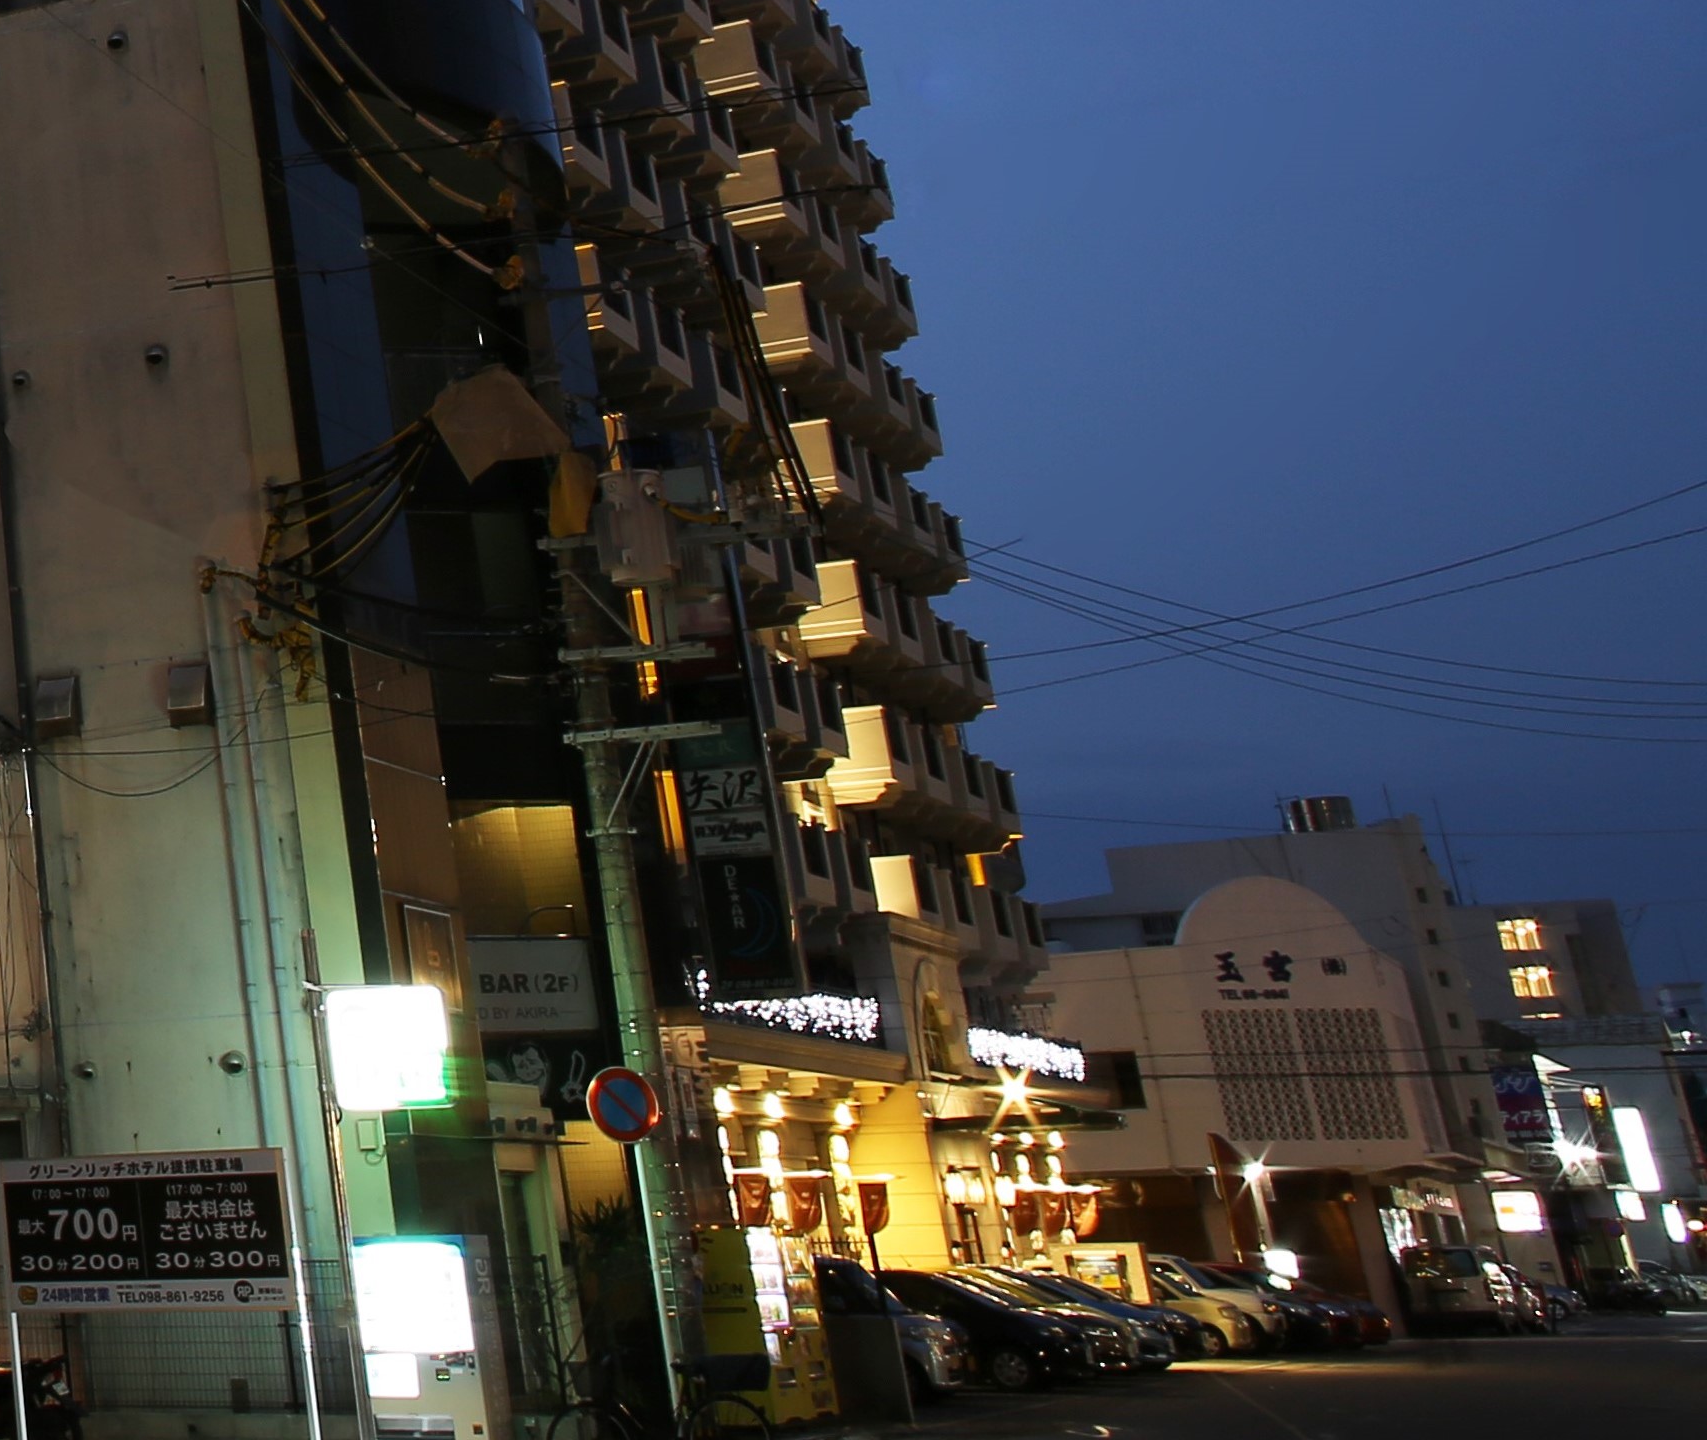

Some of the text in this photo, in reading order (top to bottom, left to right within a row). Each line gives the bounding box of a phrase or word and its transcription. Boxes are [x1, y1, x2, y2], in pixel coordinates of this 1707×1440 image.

[478, 972, 531, 994] BAR
[492, 1006, 510, 1020] BY
[514, 1005, 559, 1019] AKIRA
[164, 1198, 256, 1221] 最大料金は
[159, 1220, 267, 1243] ございません
[41, 1286, 112, 1303] 24時間営業
